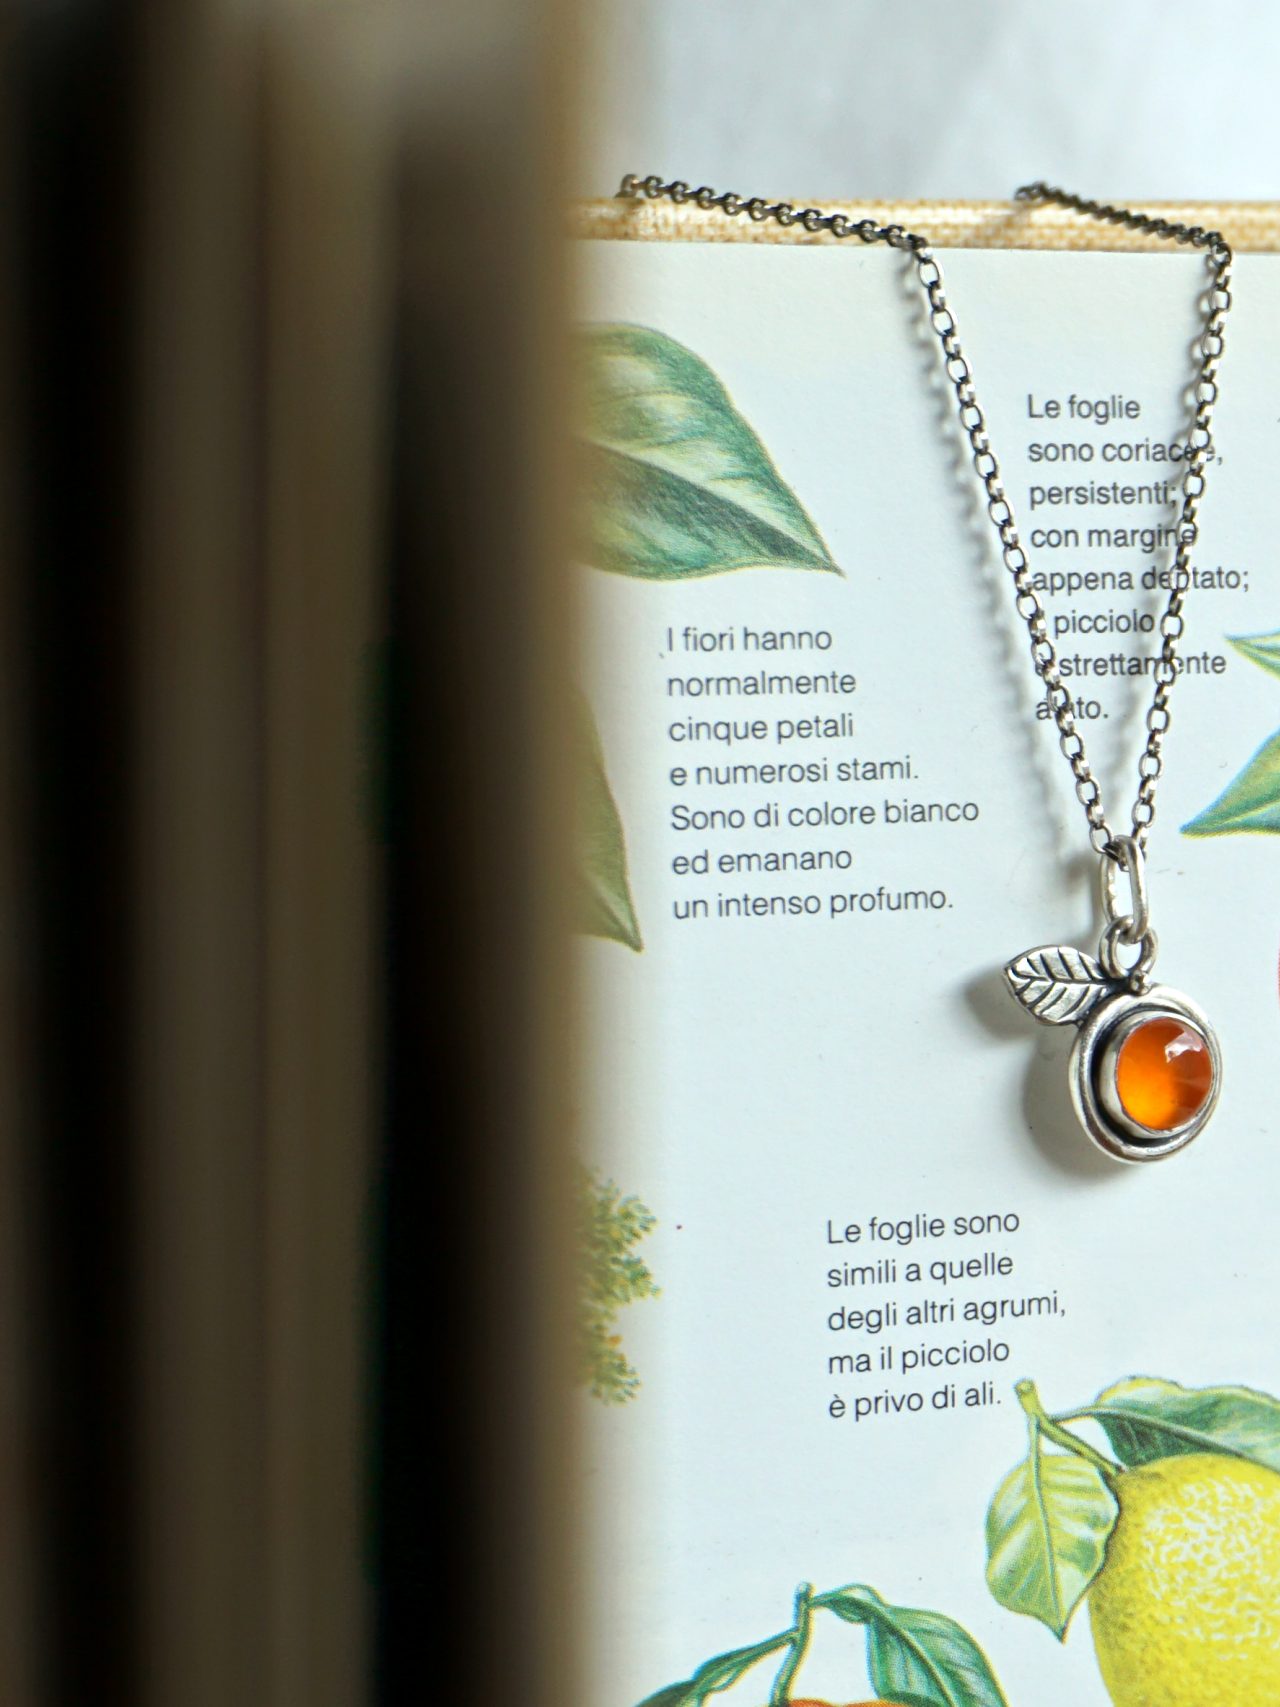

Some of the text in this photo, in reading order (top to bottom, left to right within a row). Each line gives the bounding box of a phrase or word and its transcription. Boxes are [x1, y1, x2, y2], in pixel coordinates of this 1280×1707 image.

[1028, 393, 1140, 425] Le foglie
[1028, 442, 1094, 462] sono
[1029, 480, 1178, 511] persistenti;
[1031, 528, 1079, 548] con
[1032, 569, 1134, 596] appena
[667, 626, 833, 652] I fiori hanno
[1054, 609, 1156, 640] picciolo
[667, 670, 857, 697] normalmente
[668, 712, 854, 746] cinque petali
[669, 755, 919, 786] e numerosi stami.
[671, 799, 980, 831] Sono di colore bianco
[672, 849, 853, 876] ed emanano
[674, 886, 954, 920] un intenso profumo.
[827, 1213, 1020, 1246] Le foglie sono
[827, 1252, 1014, 1288] simili a quelle
[827, 1290, 1066, 1334] degli altri agrumi,
[828, 1338, 1010, 1375] ma il picciolo
[828, 1381, 1001, 1422] è privo di ali.
